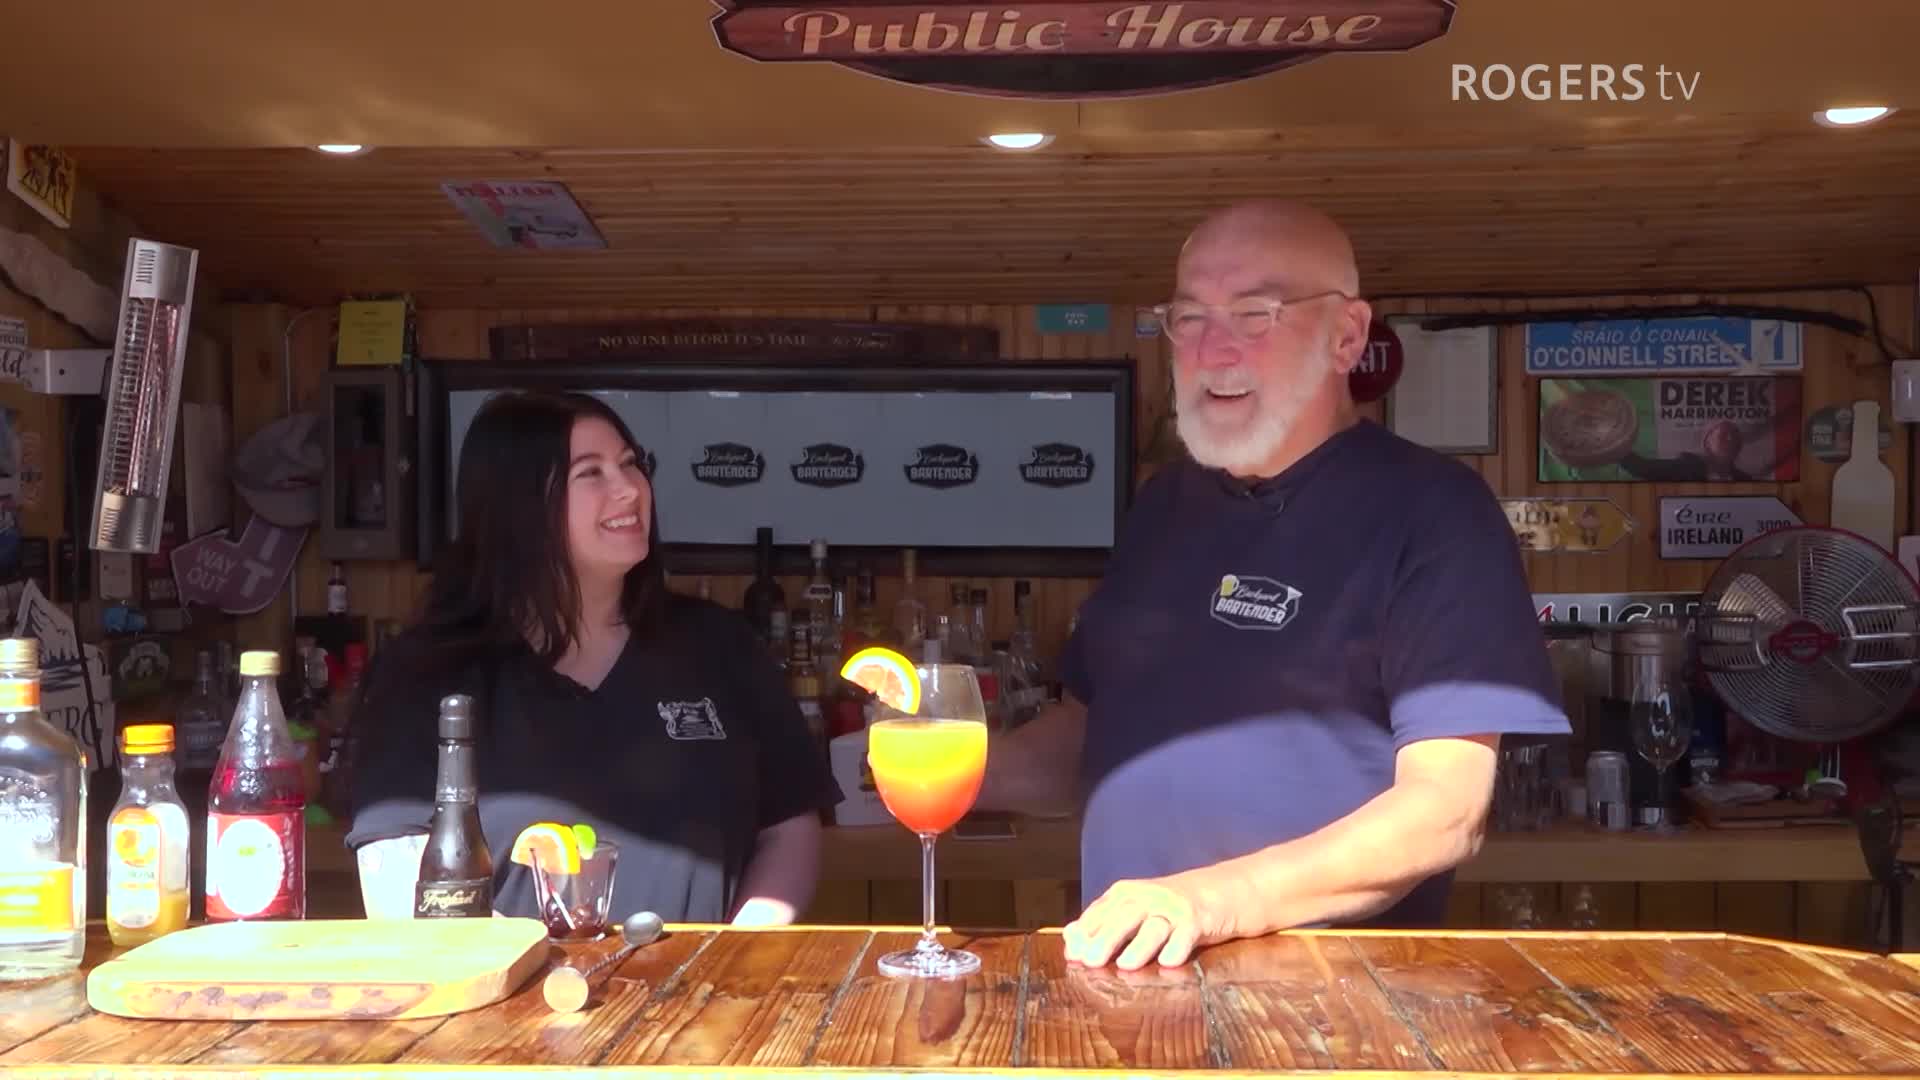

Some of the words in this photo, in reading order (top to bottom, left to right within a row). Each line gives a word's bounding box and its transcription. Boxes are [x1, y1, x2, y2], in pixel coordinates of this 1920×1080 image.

[783, 8, 1067, 54] Public
[1105, 4, 1382, 50] House
[1533, 345, 1658, 368] O'CONNELL
[1660, 380, 1771, 407] DEREK
[1661, 407, 1770, 420] HARRINGTON
[697, 465, 759, 480] BARTENDER
[796, 465, 858, 480] BARTENDER
[909, 465, 974, 481] BARTENDER
[1025, 465, 1089, 480] BARTENDER
[1667, 527, 1744, 545] IRELAND
[195, 546, 238, 576] WAY
[186, 566, 228, 594] OUT
[1214, 597, 1287, 625] BARTENDER
